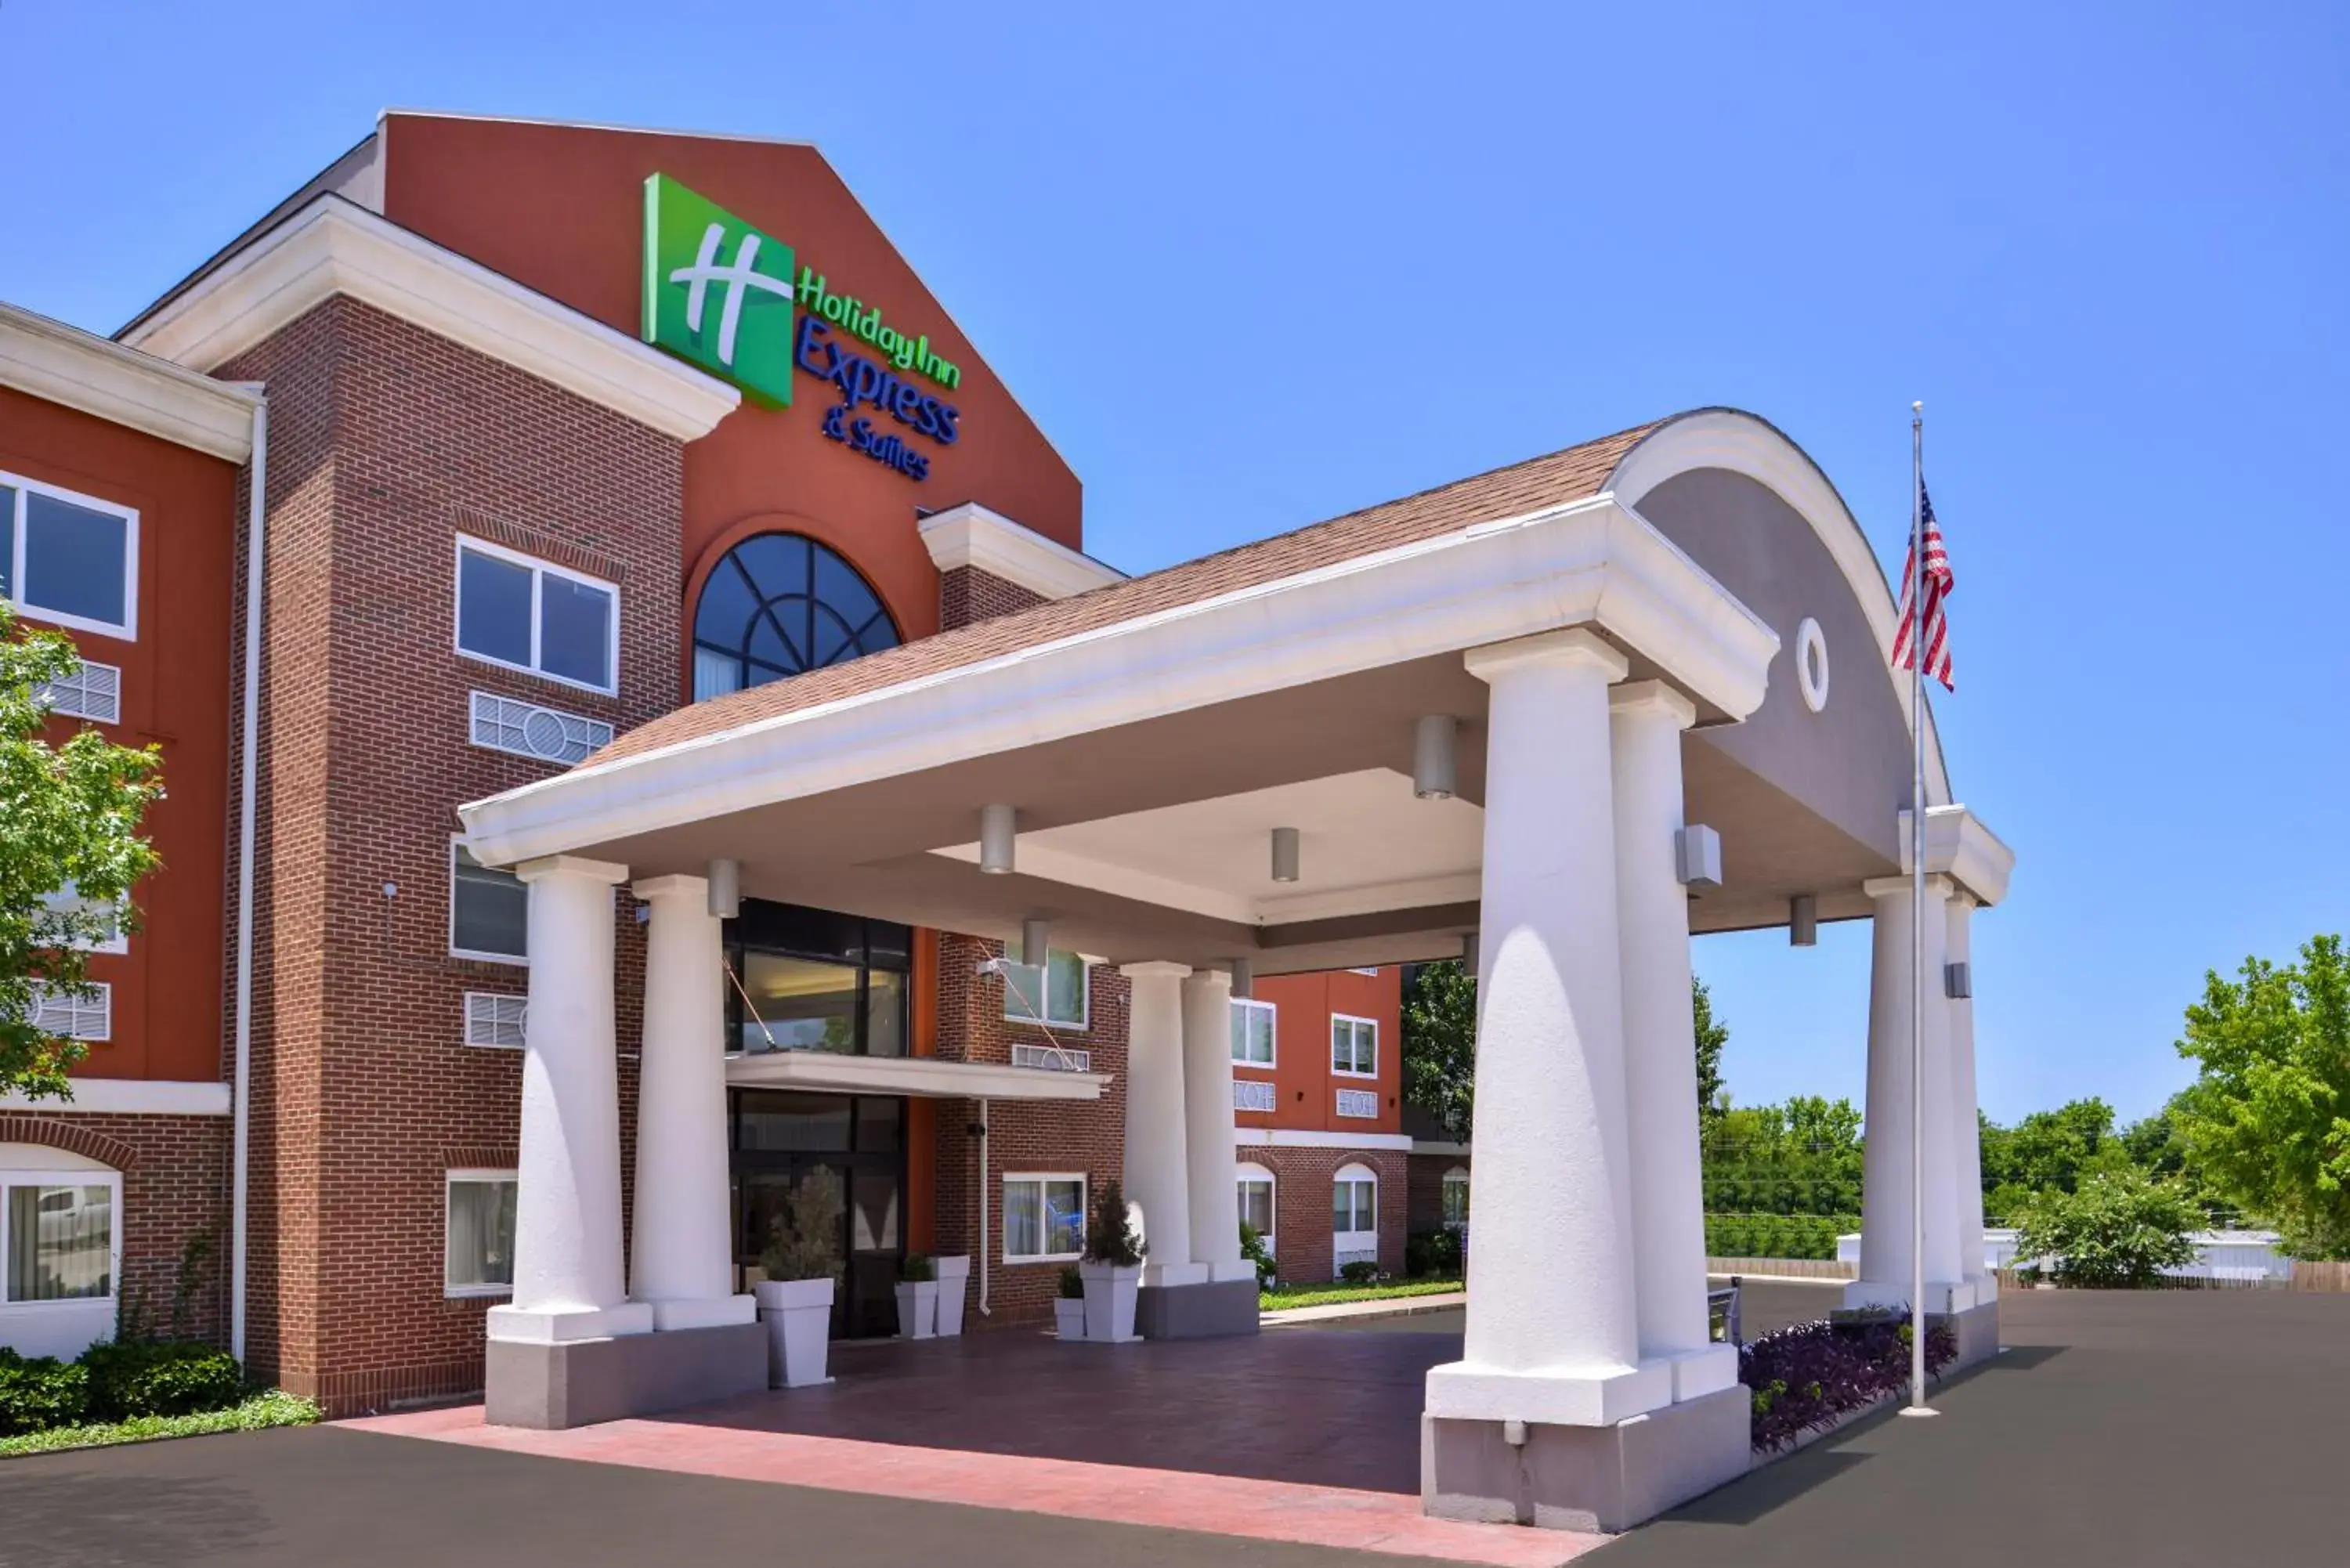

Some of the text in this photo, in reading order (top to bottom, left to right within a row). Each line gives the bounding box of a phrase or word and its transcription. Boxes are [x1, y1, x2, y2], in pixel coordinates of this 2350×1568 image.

[796, 315, 959, 445] Express
[822, 405, 931, 481] & Suites
